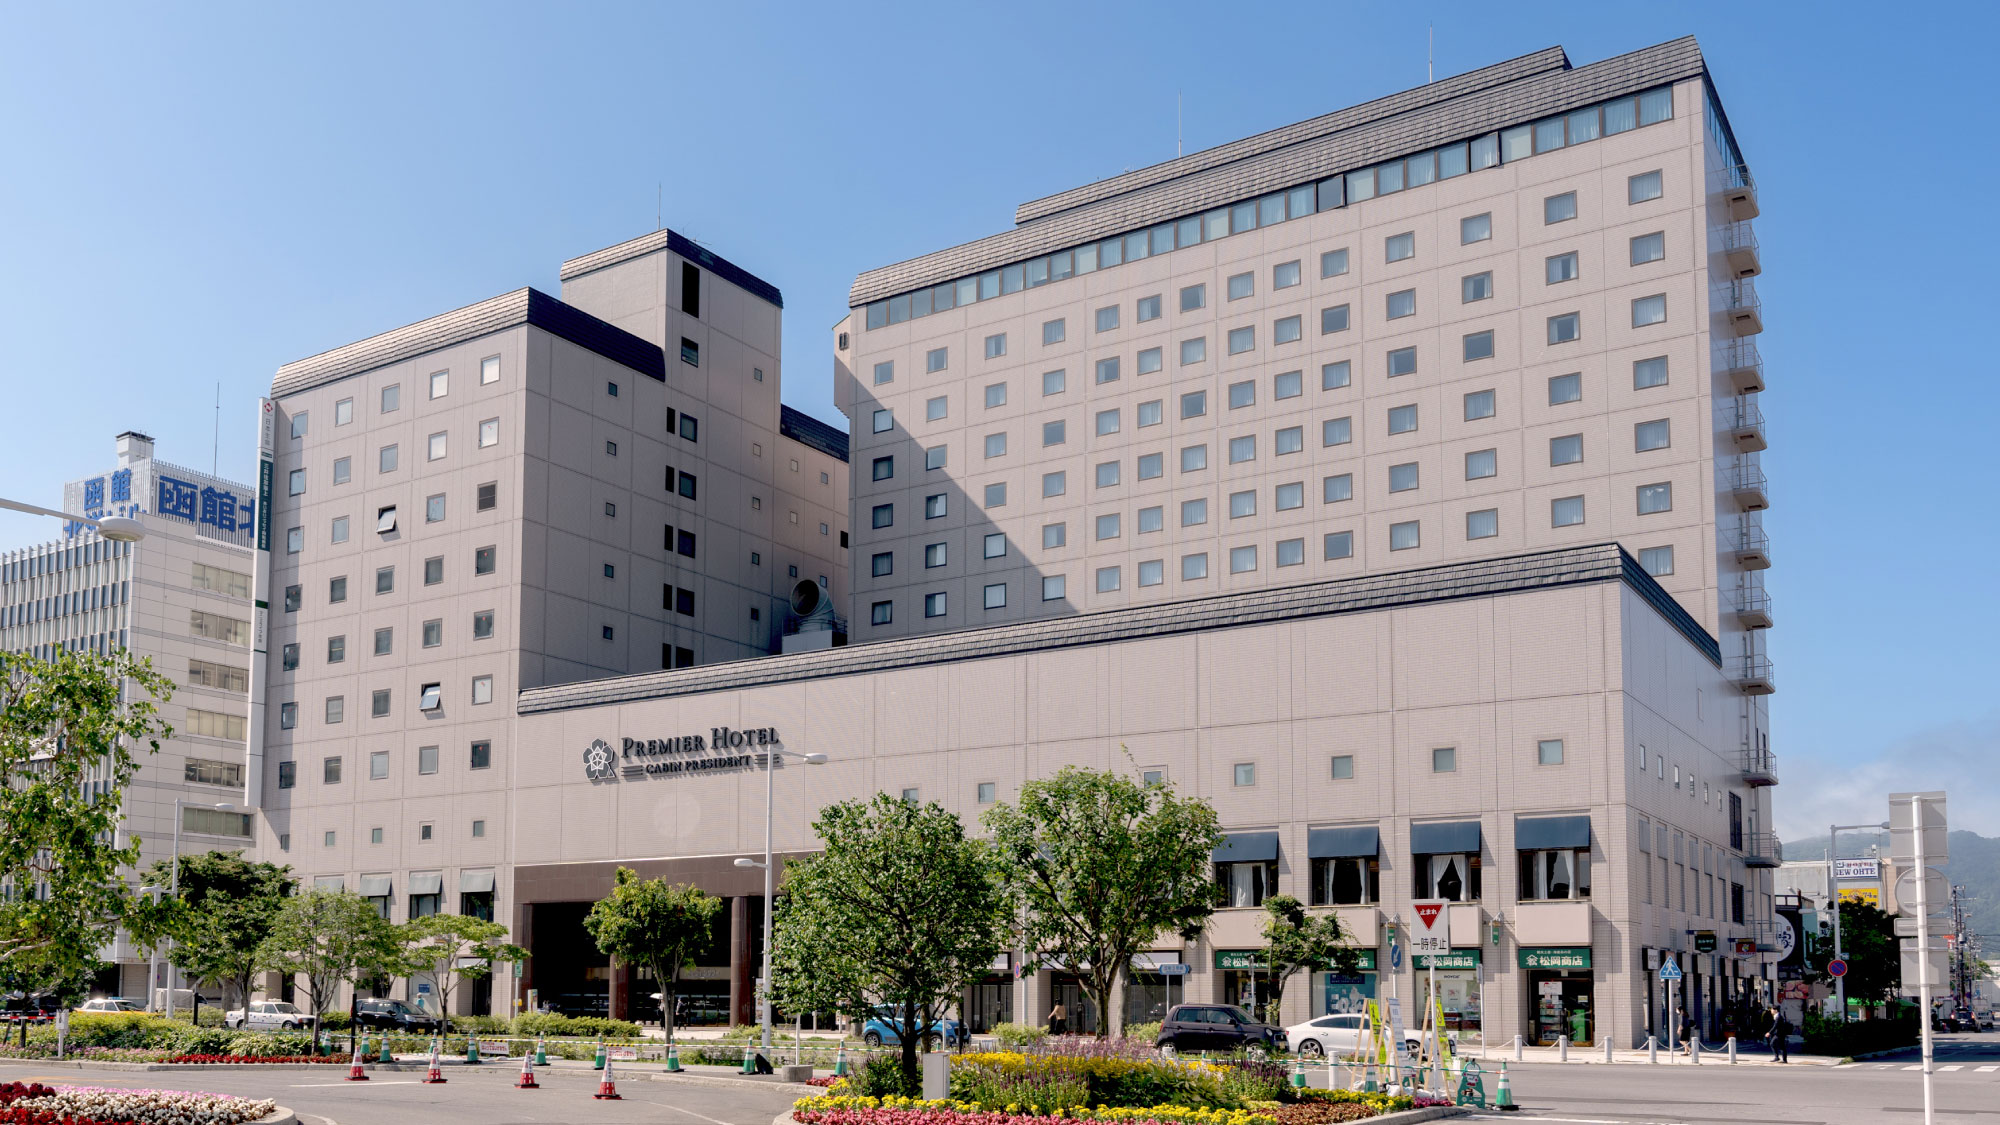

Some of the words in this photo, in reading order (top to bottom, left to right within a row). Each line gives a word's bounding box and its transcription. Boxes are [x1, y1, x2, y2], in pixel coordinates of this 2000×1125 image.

[84, 467, 131, 511] 函館
[621, 734, 705, 758] PREMIER
[710, 726, 779, 750] HOTEL
[646, 761, 682, 775] CABIN
[684, 755, 751, 772] PRESIDENT
[1853, 867, 1876, 876] OHTE
[1412, 937, 1447, 951] 一時停止
[1434, 956, 1474, 967] 松岡商店
[1539, 955, 1583, 966] 松岡商店
